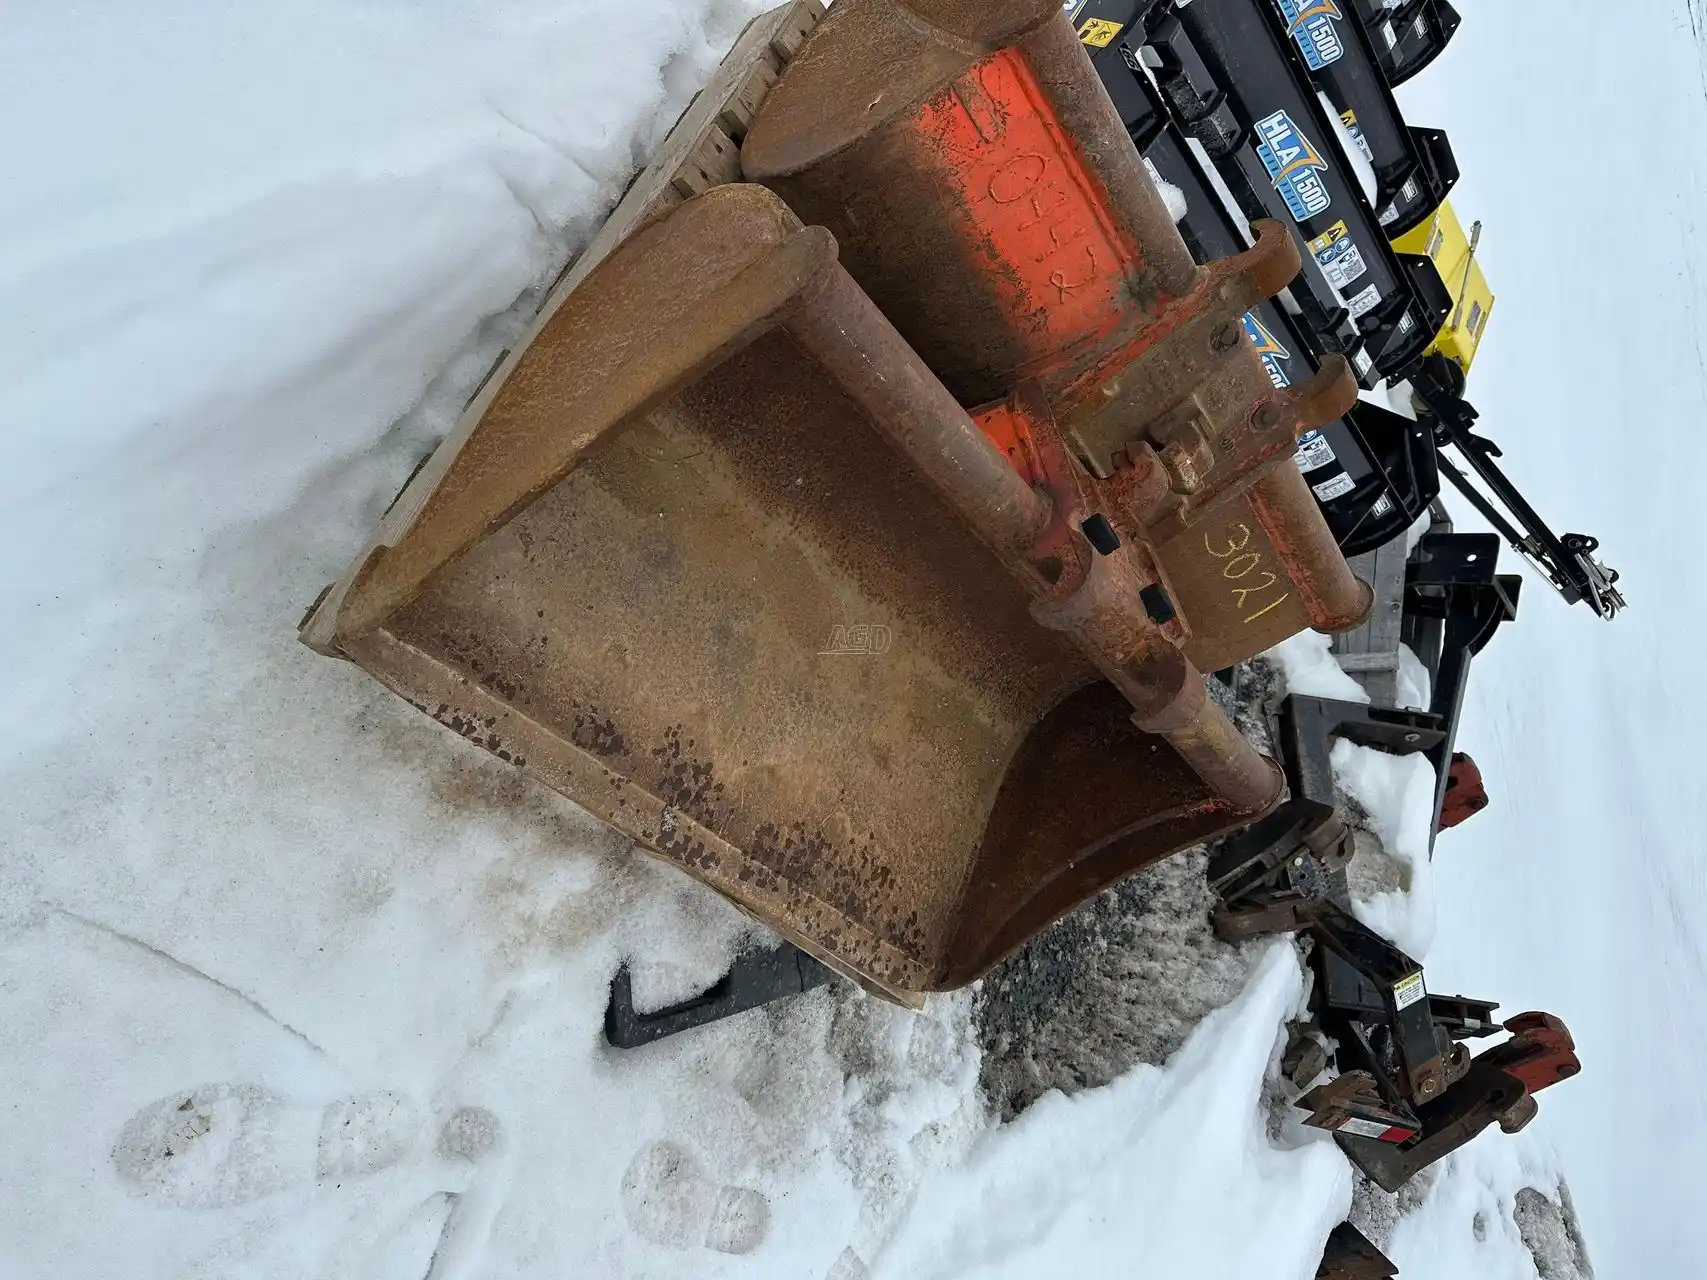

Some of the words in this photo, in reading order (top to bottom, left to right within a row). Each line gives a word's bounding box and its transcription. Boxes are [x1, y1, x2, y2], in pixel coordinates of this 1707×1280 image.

[1308, 16, 1340, 61] 1500
[1260, 113, 1301, 166] HLA
[1291, 168, 1327, 212] 1500
[1204, 524, 1289, 623] 3021
